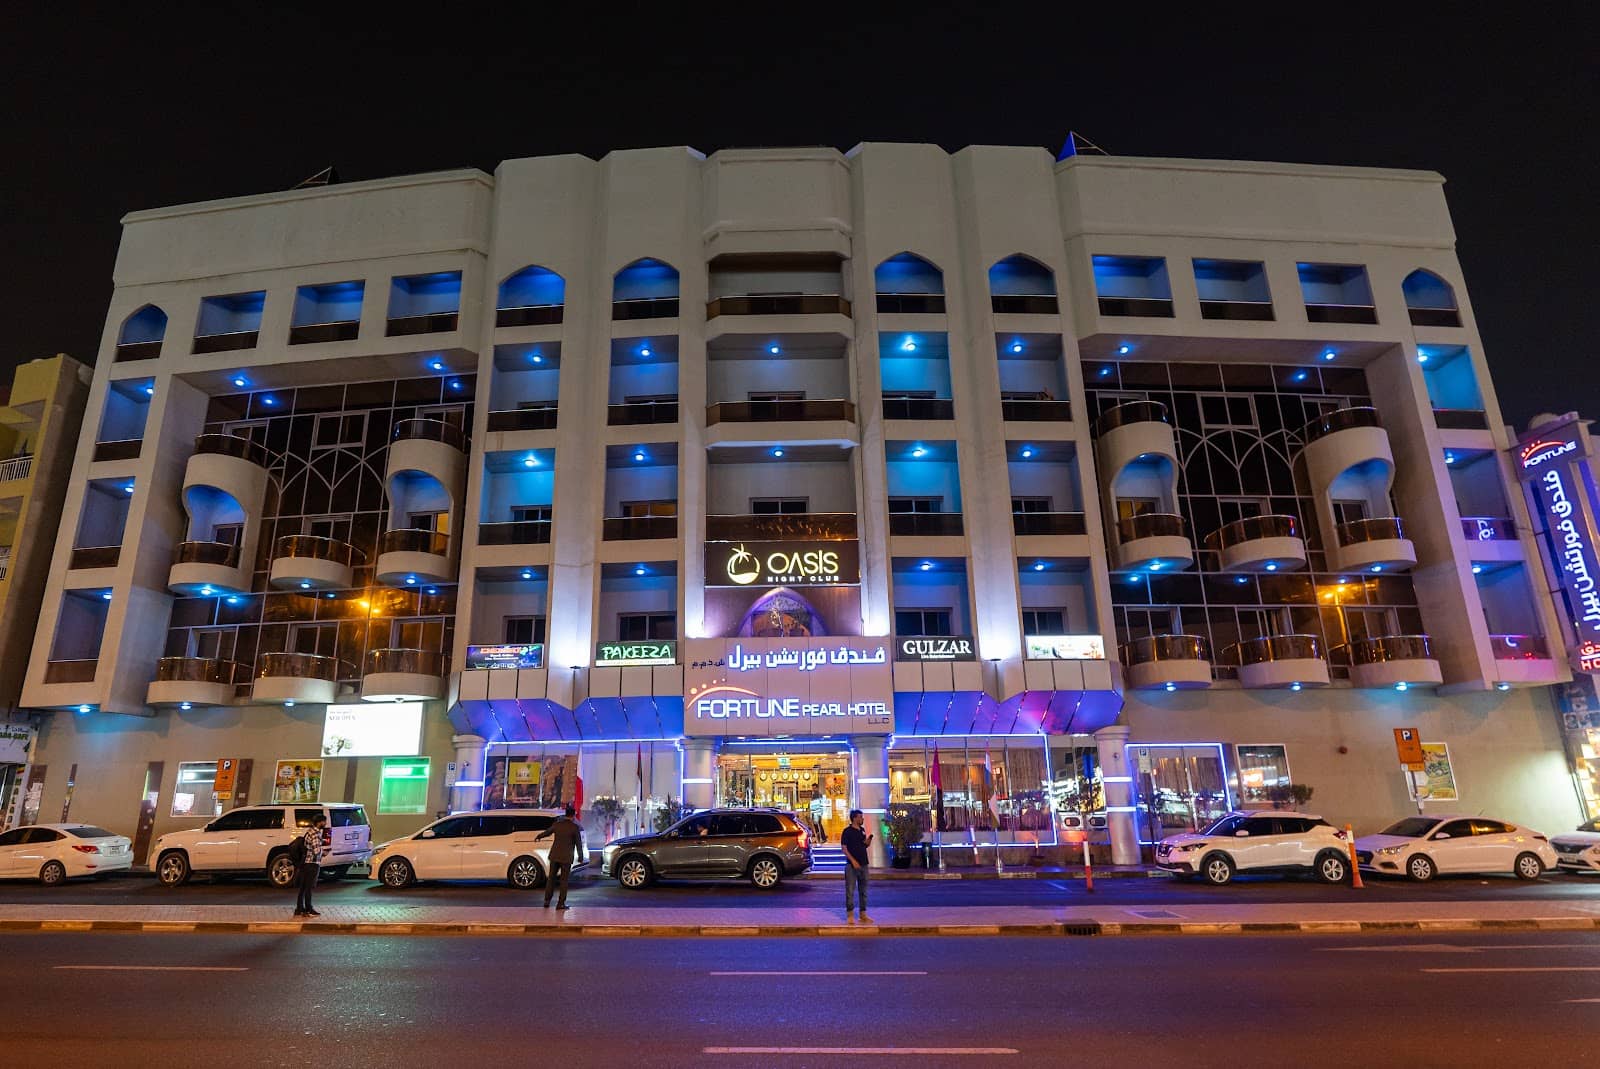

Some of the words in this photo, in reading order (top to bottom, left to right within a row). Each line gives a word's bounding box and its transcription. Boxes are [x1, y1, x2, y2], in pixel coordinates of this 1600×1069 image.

[1524, 441, 1577, 468] FORTUNE
[1543, 470, 1572, 518] فندق
[767, 549, 839, 576] OASIS
[1557, 519, 1594, 592] فورتشن
[602, 644, 671, 660] PAKEEZA
[728, 644, 762, 671] بيرل
[830, 646, 886, 664] فندق
[902, 639, 972, 655] GULZAR
[765, 647, 827, 671] فورتشن
[697, 698, 800, 718] FORTUNE
[802, 703, 846, 717] PEARL
[847, 702, 891, 716] HOTEL
[1402, 729, 1411, 741] P
[223, 759, 232, 770] P
